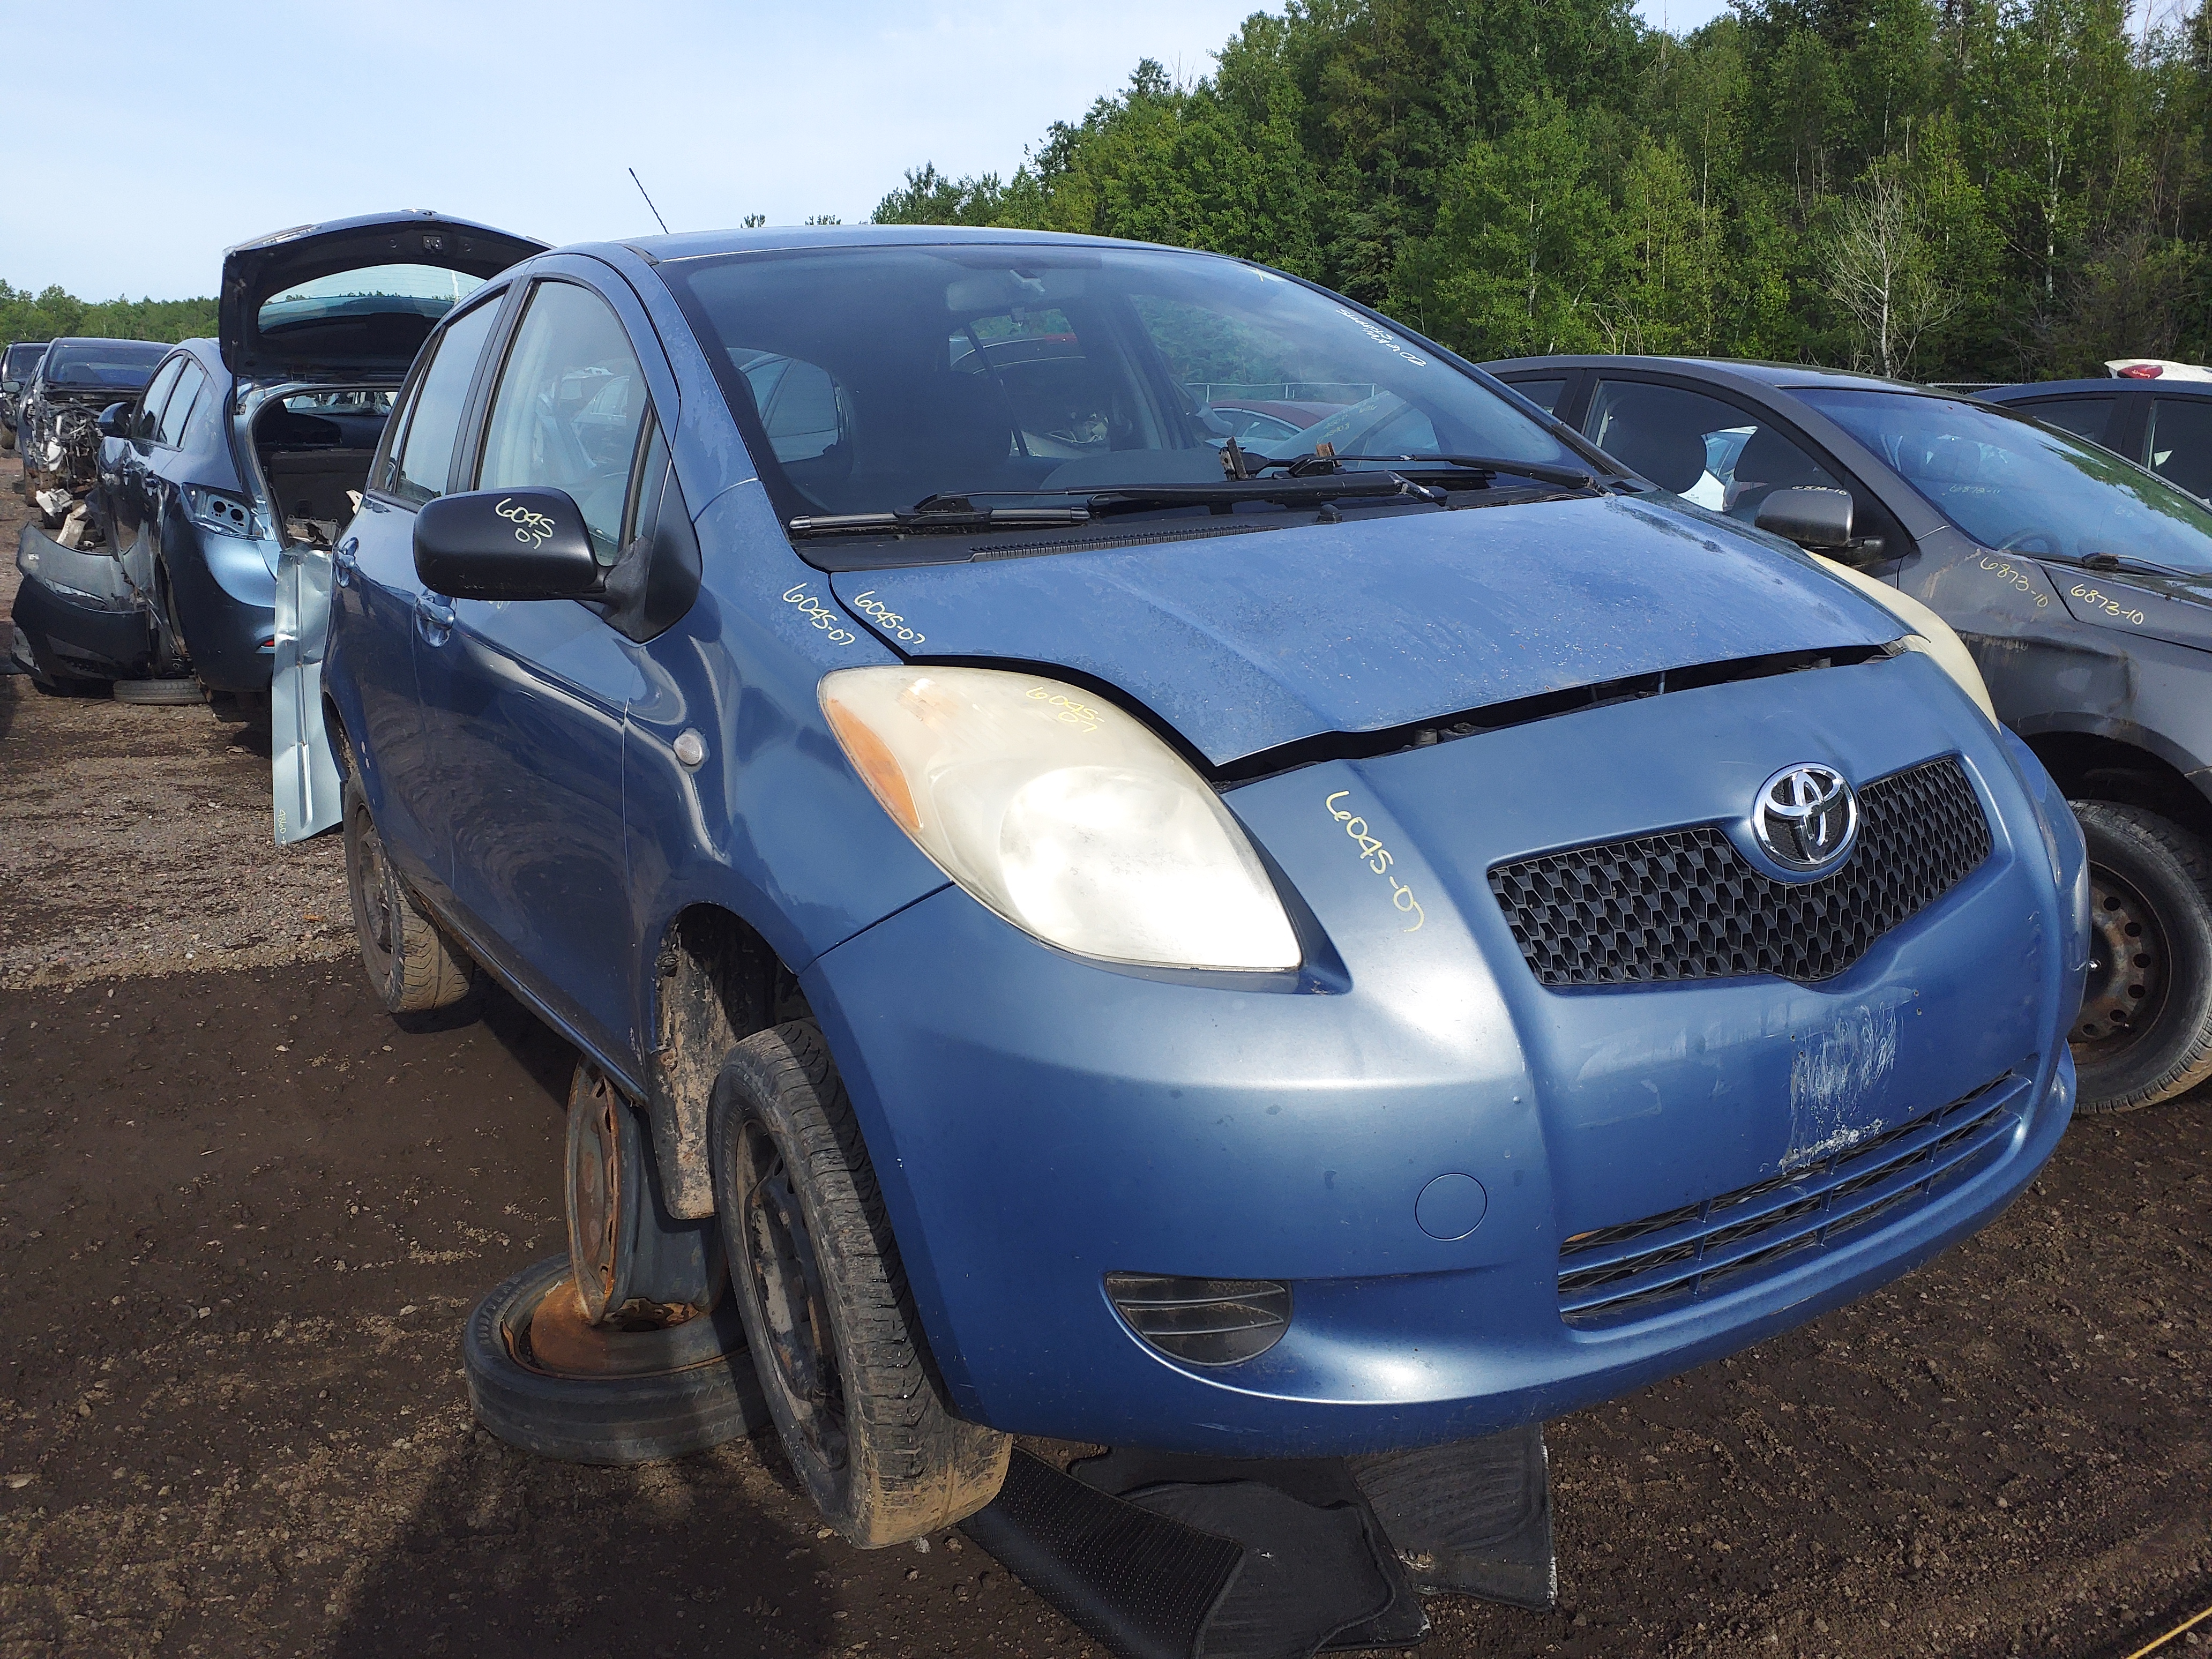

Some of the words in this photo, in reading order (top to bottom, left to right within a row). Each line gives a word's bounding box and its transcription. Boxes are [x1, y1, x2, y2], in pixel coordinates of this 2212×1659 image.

[495, 497, 555, 538] 6045
[514, 527, 542, 549] 07
[1979, 556, 2049, 608] 6873-10
[2069, 583, 2144, 626] 6873-10
[782, 582, 856, 646] 6045-07
[854, 590, 926, 645] 6045-07
[1057, 711, 1098, 733] 07
[1325, 790, 1424, 933] 6045-07
